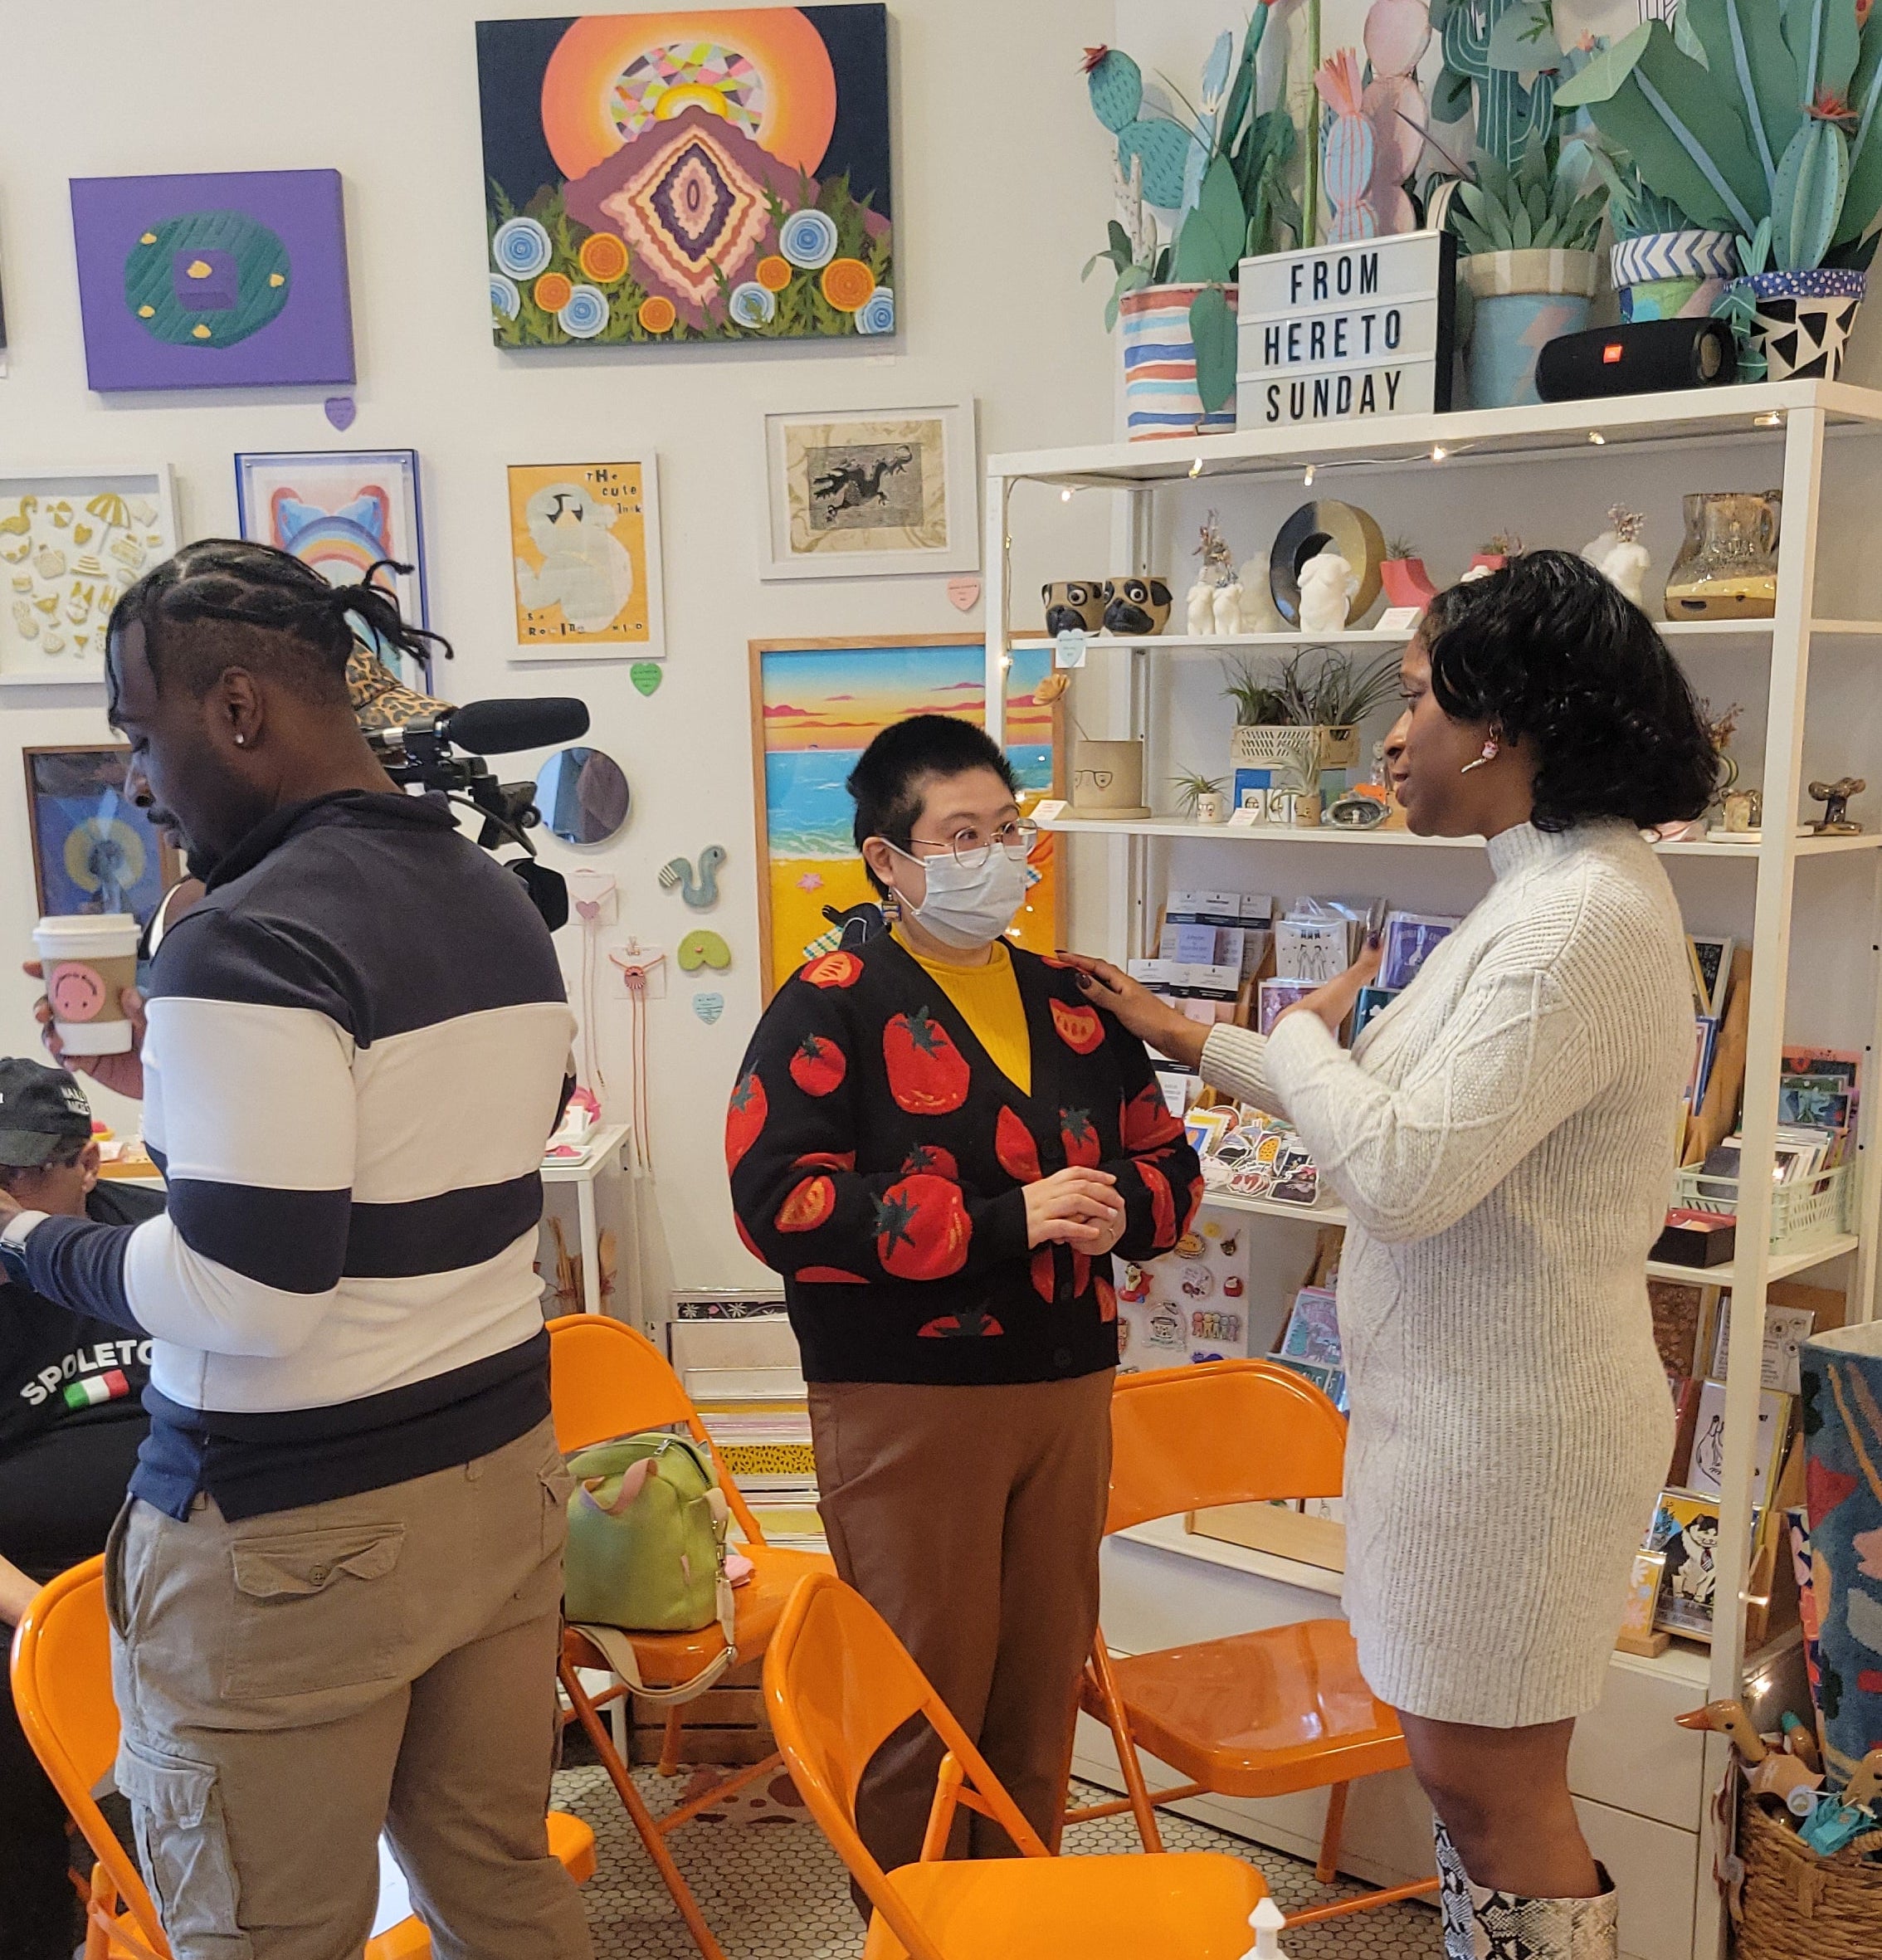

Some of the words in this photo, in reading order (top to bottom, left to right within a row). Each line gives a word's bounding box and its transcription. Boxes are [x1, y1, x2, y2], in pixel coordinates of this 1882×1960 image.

[1290, 252, 1378, 305] FROM
[1264, 317, 1348, 366] HERE
[1361, 310, 1402, 355] TO
[1266, 371, 1402, 423] SUNDAY
[602, 485, 637, 497] cute
[19, 1338, 153, 1407] SPOLETO
